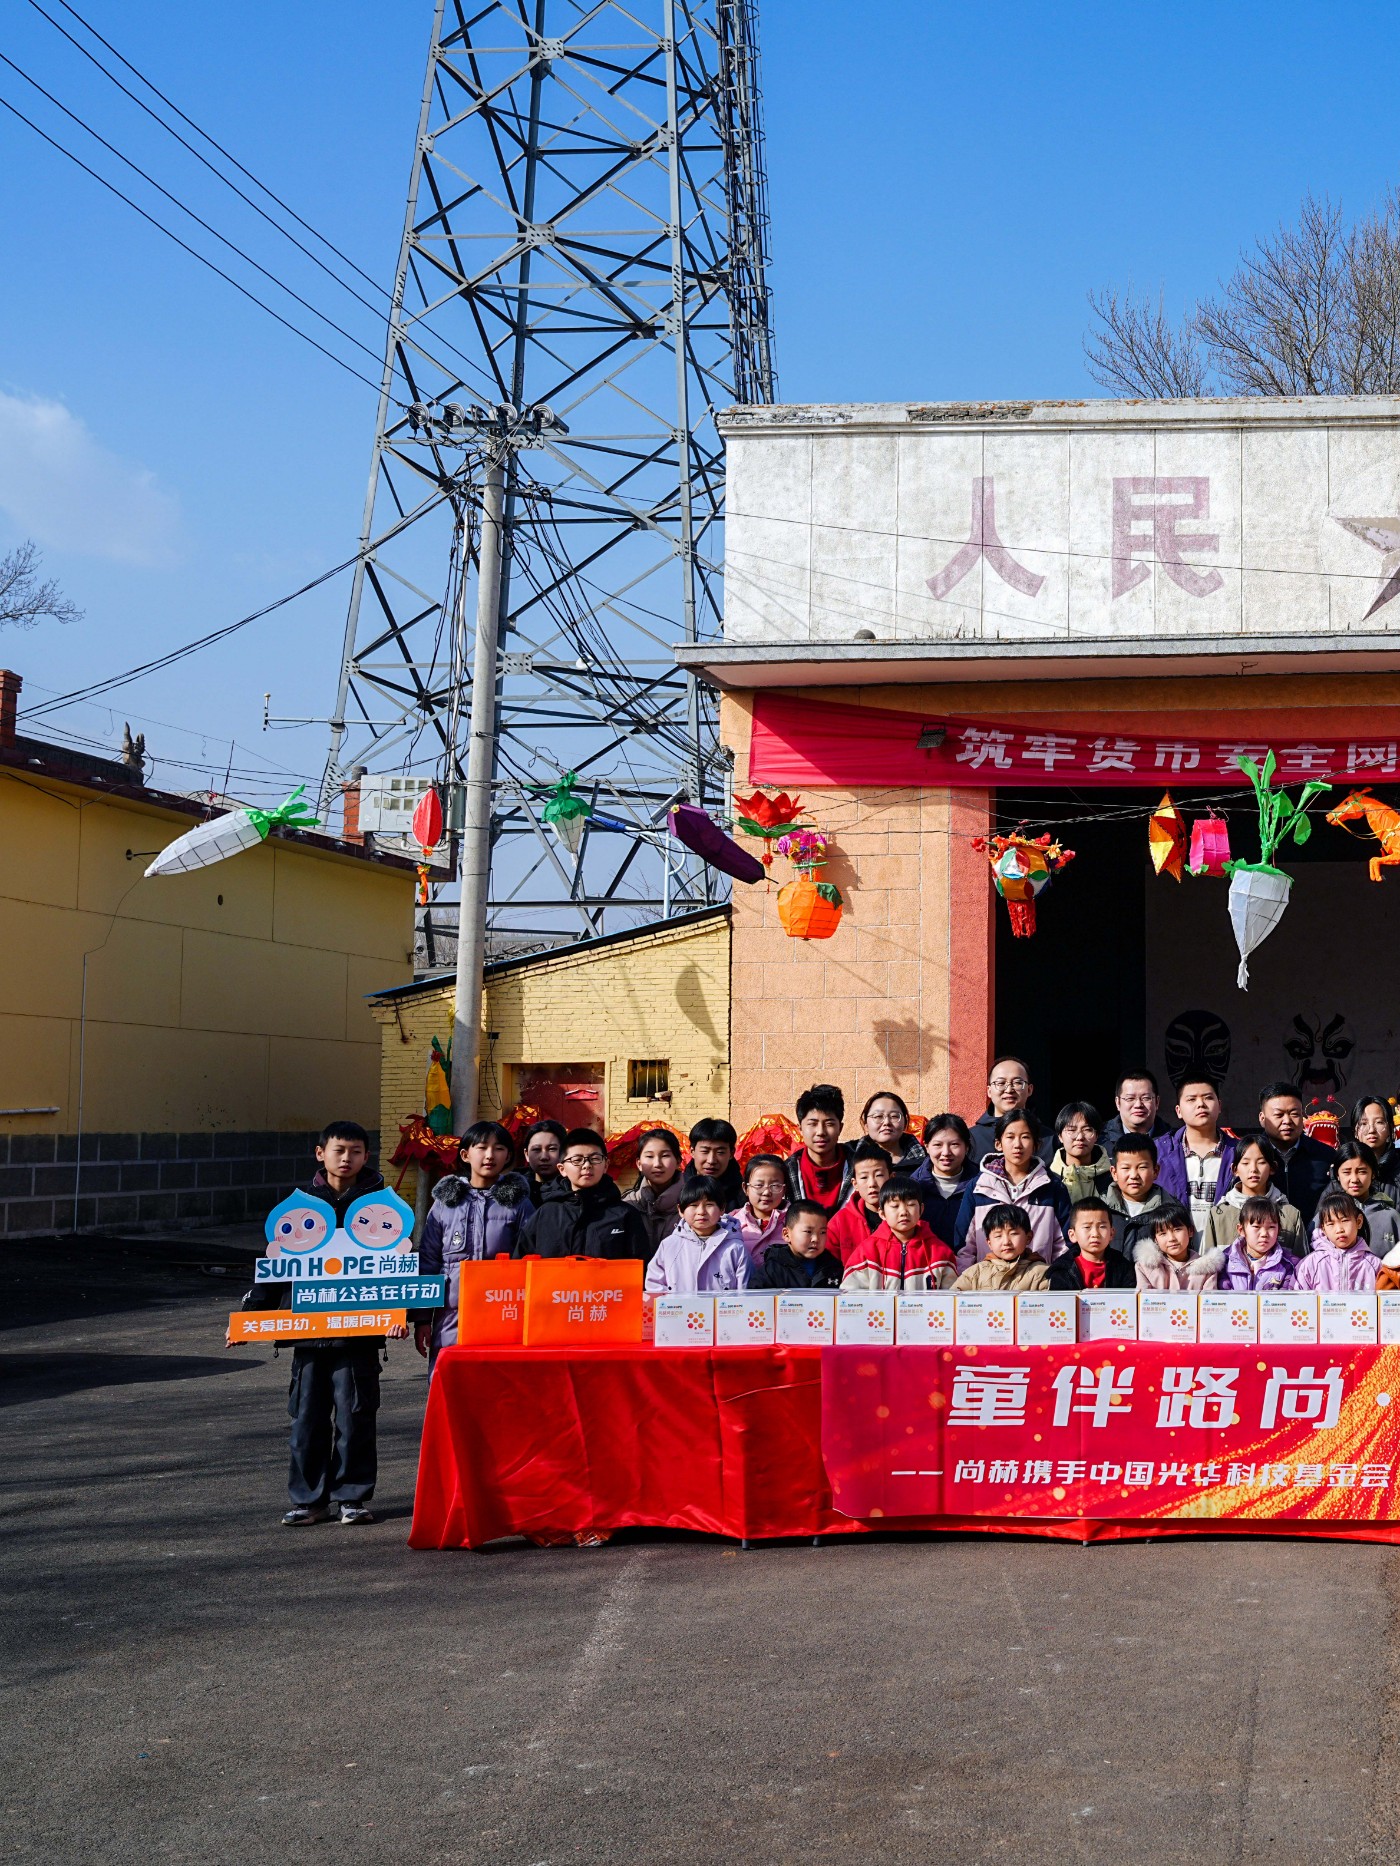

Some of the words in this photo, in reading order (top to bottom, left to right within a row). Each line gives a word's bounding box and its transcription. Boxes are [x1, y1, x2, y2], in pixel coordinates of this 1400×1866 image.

[925, 476, 1224, 600] 人民
[256, 1257, 302, 1279] SUN
[308, 1255, 376, 1277] HOPE
[378, 1254, 418, 1275] 尚赫
[296, 1283, 440, 1304] 尚赫公益在行动
[485, 1289, 513, 1303] SUN
[551, 1289, 579, 1304] SUN
[583, 1289, 624, 1303] HOPE
[568, 1304, 608, 1323] 尚赫
[953, 1459, 1391, 1489] 尚赫携手中国光华科技基金会
